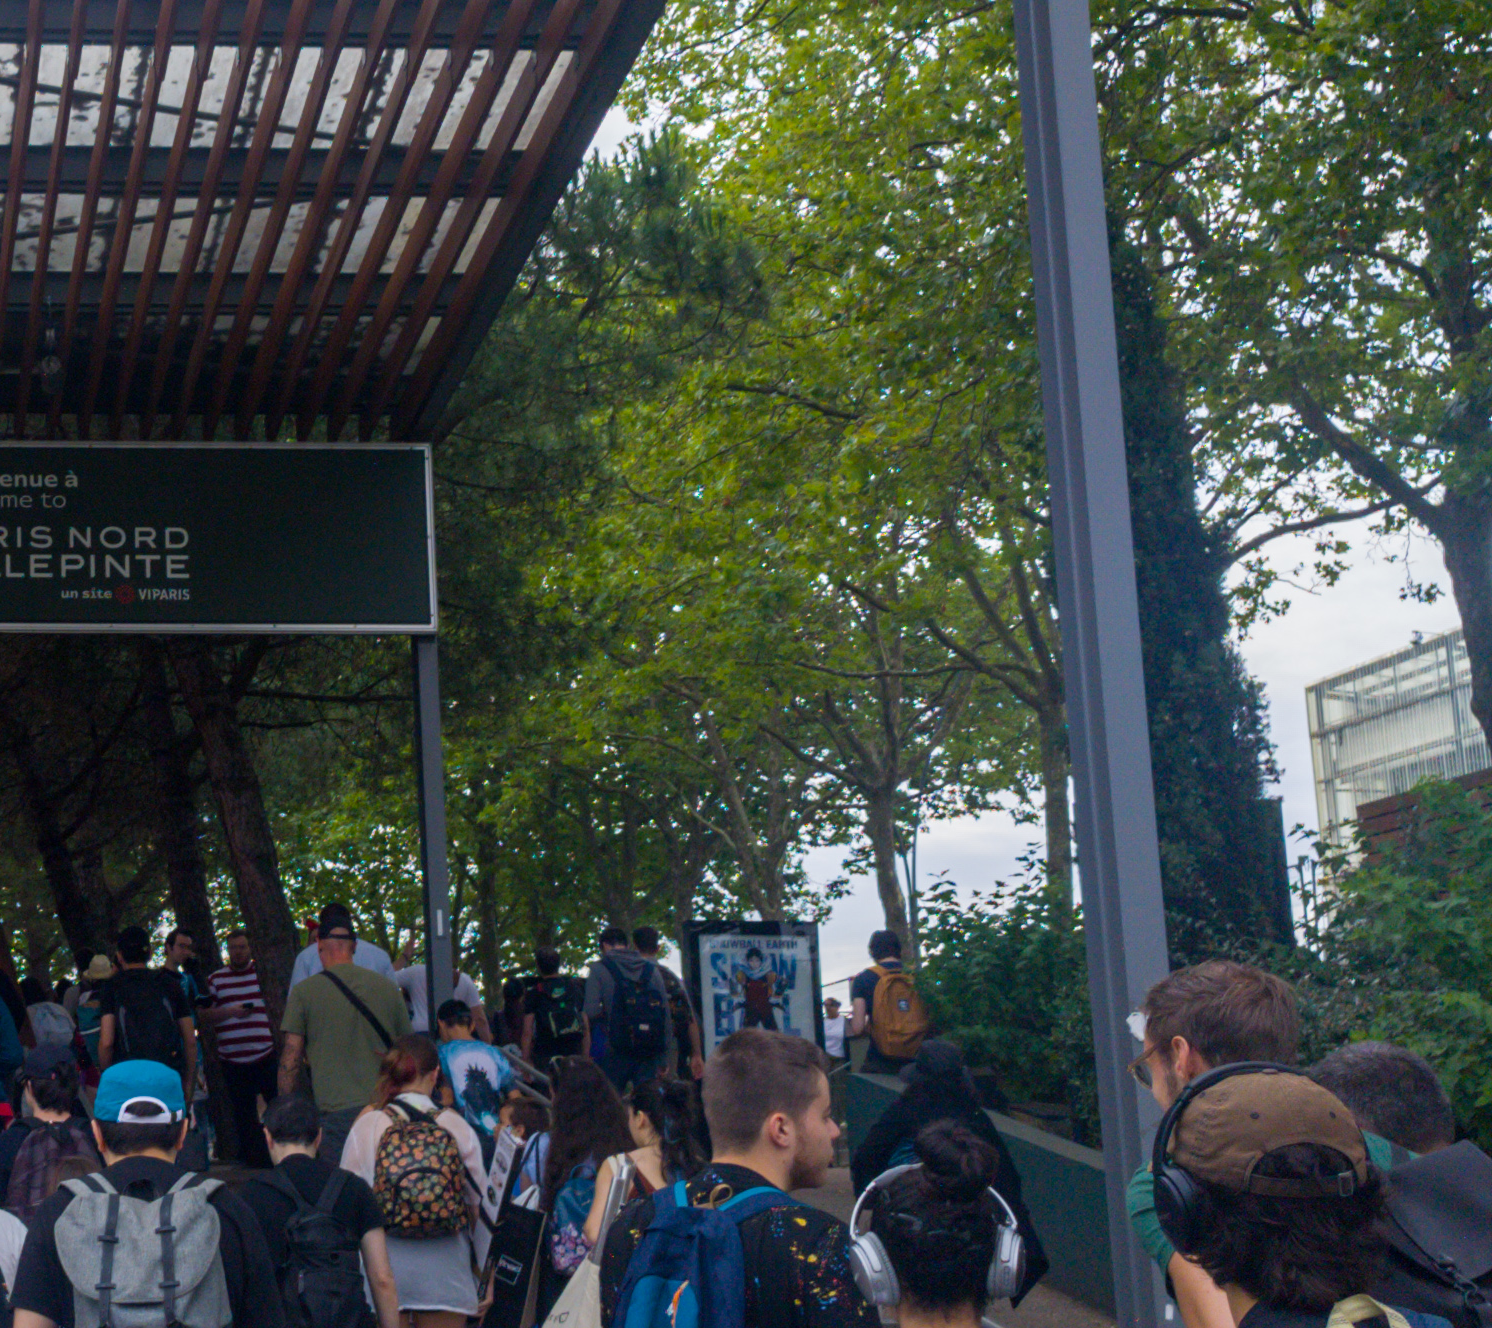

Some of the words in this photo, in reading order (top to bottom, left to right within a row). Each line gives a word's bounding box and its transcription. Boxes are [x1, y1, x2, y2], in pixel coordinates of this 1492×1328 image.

[64, 469, 79, 488] à
[40, 493, 67, 509] to
[68, 526, 190, 549] NORD
[60, 589, 79, 599] un
[82, 587, 113, 599] site
[137, 588, 190, 601] VIPARIS
